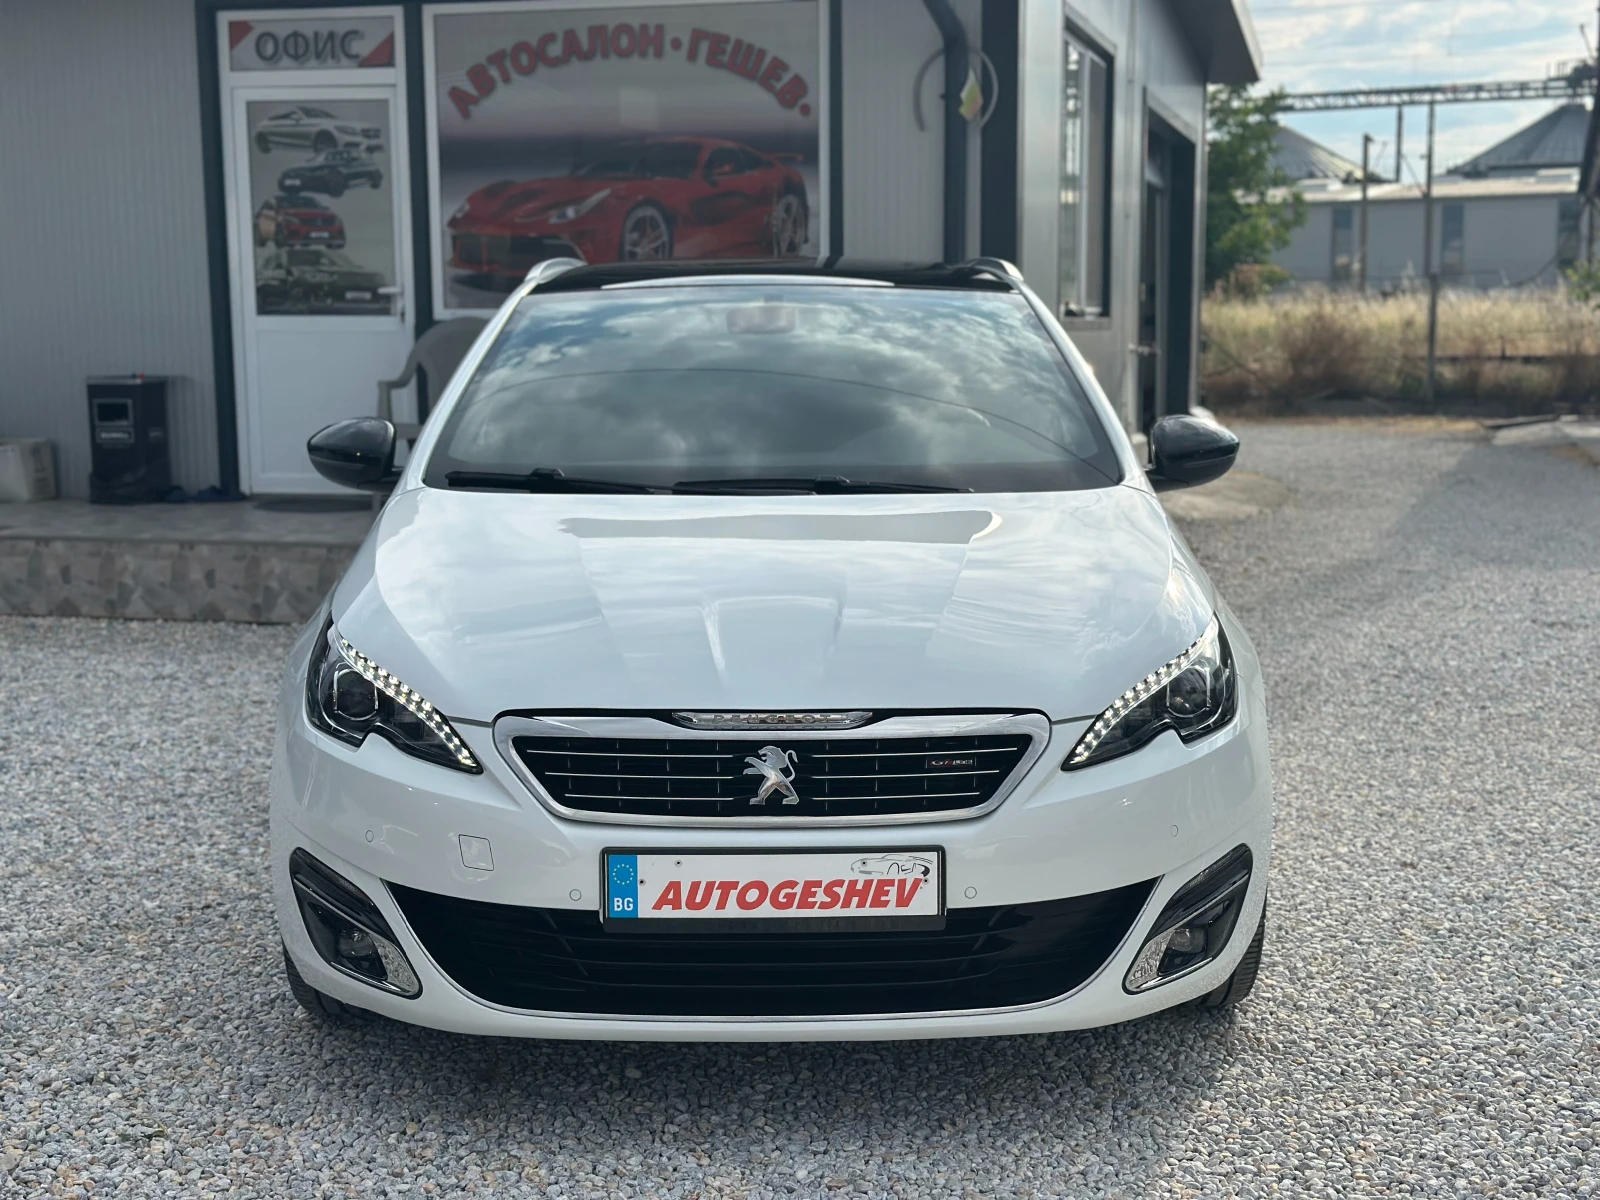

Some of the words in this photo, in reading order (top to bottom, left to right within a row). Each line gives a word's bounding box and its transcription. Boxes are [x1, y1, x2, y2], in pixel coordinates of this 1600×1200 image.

[255, 30, 363, 62] ОФИС
[449, 22, 665, 120] АВТОСАЛОН
[713, 714, 833, 724] PEUGEOT
[613, 897, 634, 911] BG
[651, 877, 923, 911] AUTOGESHEV
